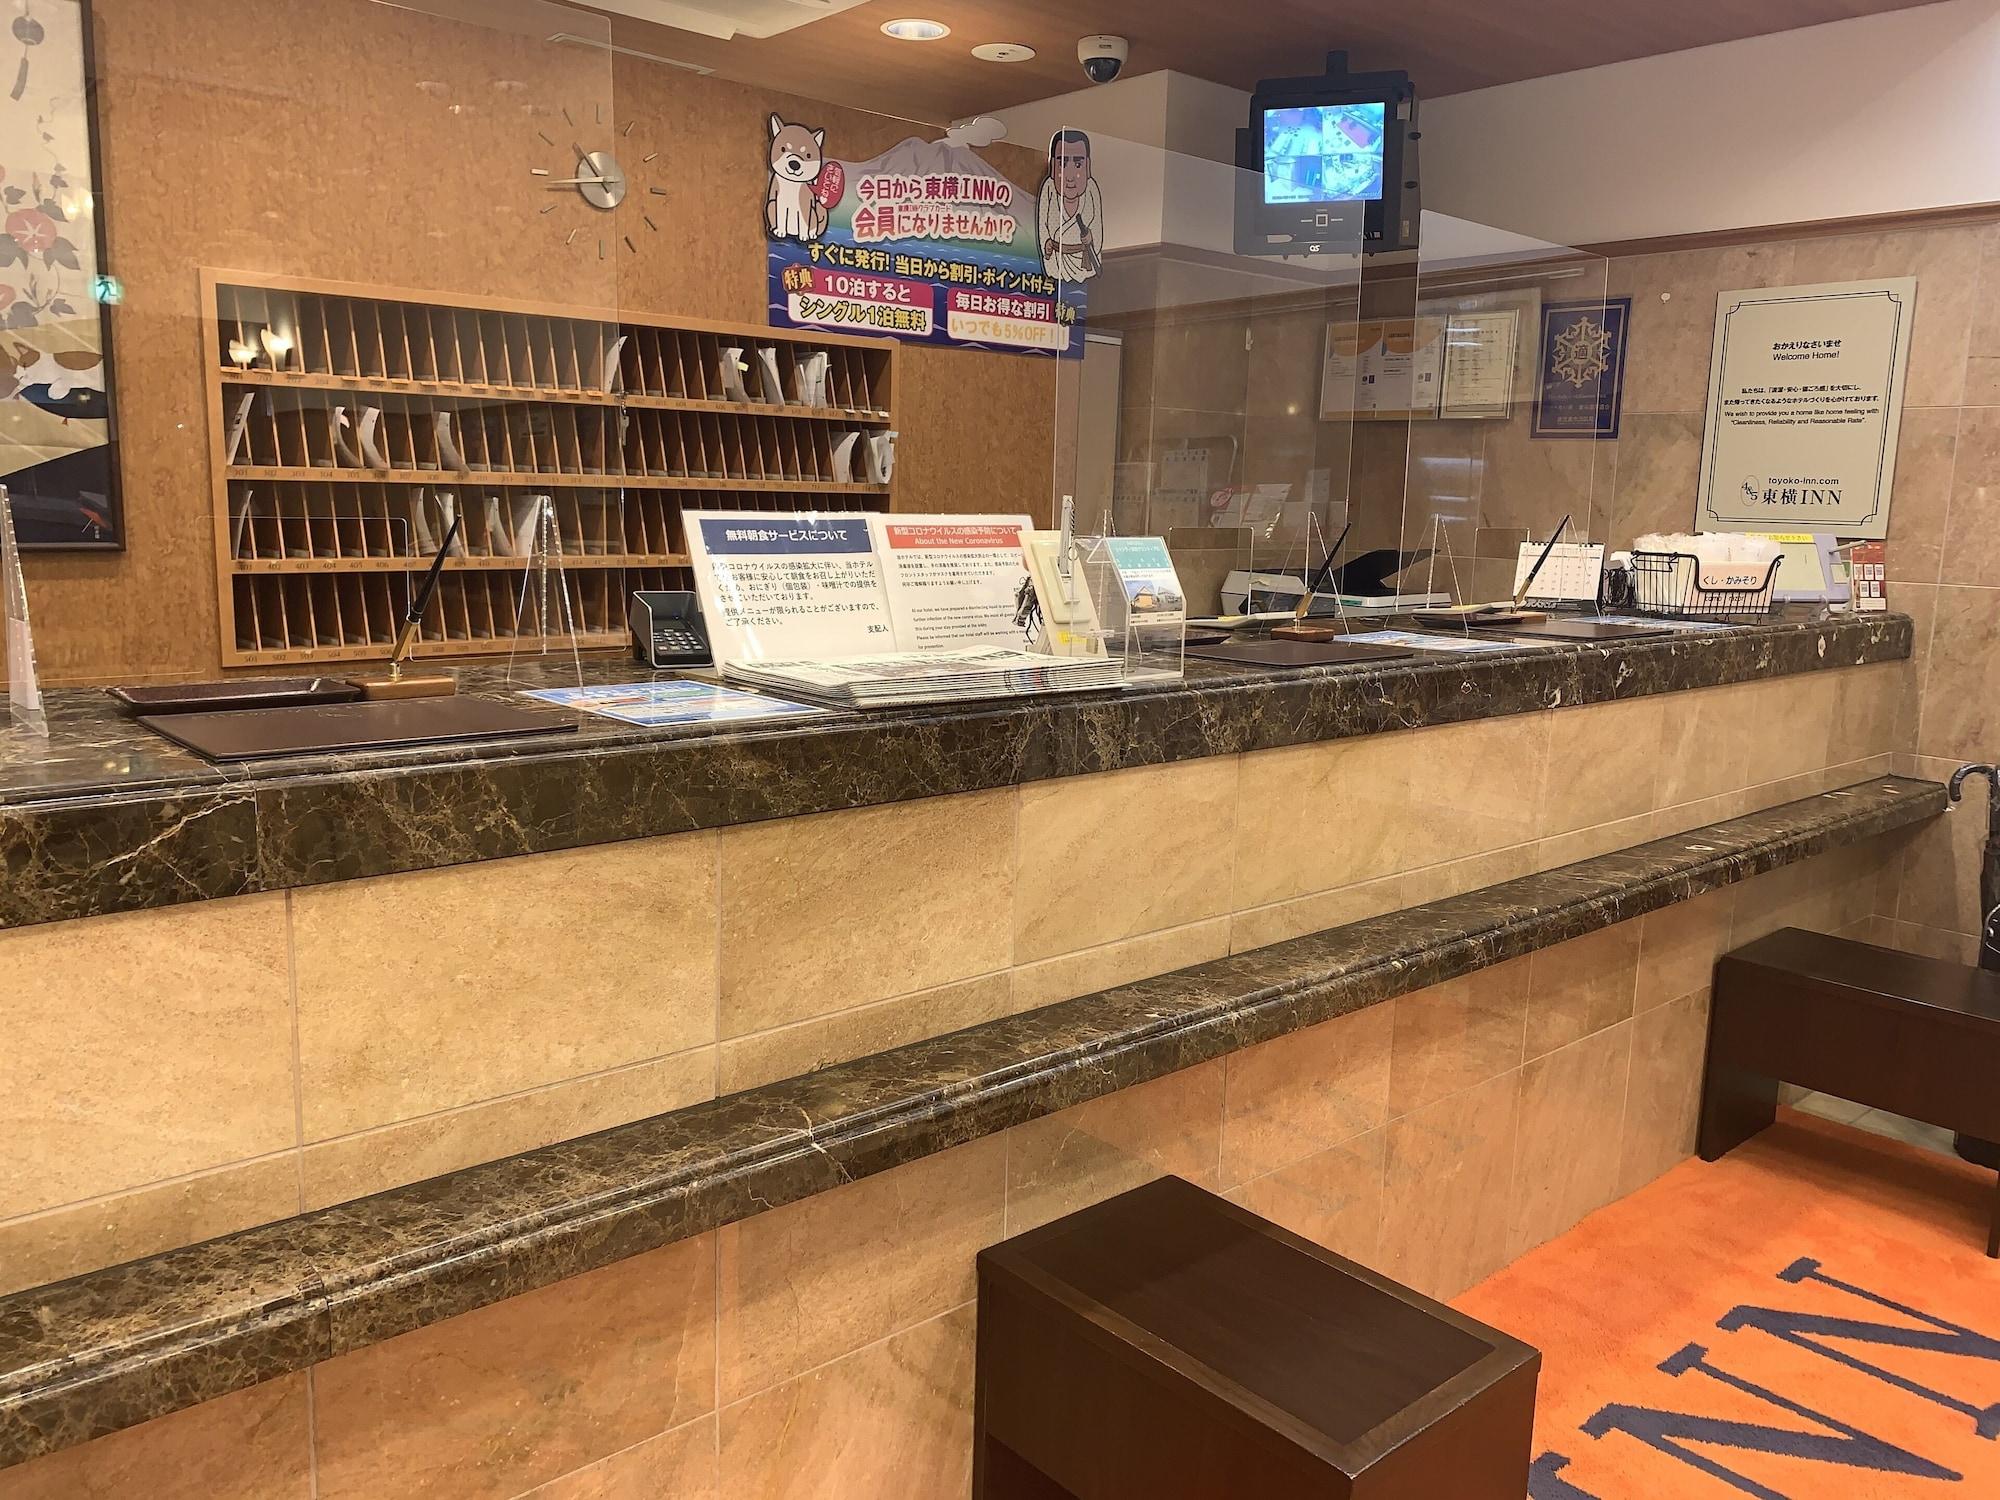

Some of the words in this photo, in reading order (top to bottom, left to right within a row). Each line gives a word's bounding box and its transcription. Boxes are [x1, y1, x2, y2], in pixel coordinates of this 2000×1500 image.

[859, 175, 1010, 202] 今日から東横INNの
[855, 206, 1013, 239] 会員になりませんか!?
[784, 268, 813, 291] 特典
[824, 275, 911, 303] 10泊すると
[955, 291, 1050, 320] 毎日お得な割引
[799, 296, 927, 332] シングル1泊無料
[1772, 339, 1842, 350] おかえりなさいませ
[1772, 352, 1810, 361] Welcome
[1812, 350, 1840, 360] Home!
[1768, 418, 1796, 426] Reliability
[1768, 476, 1839, 485] toyoko-inn.com
[1761, 488, 1842, 505] 東横INN
[725, 529, 848, 541] 無料朝食サービスについて
[894, 526, 1017, 535] 新型コロナウイルスの感染予防について
[915, 537, 935, 545] About
[965, 537, 1004, 545] Coronavirus
[267, 563, 281, 571] 402
[322, 562, 337, 570] 404
[1703, 576, 1757, 586] くし・かみそり
[726, 617, 784, 627] ご了承ください。
[867, 624, 889, 634] 支配人
